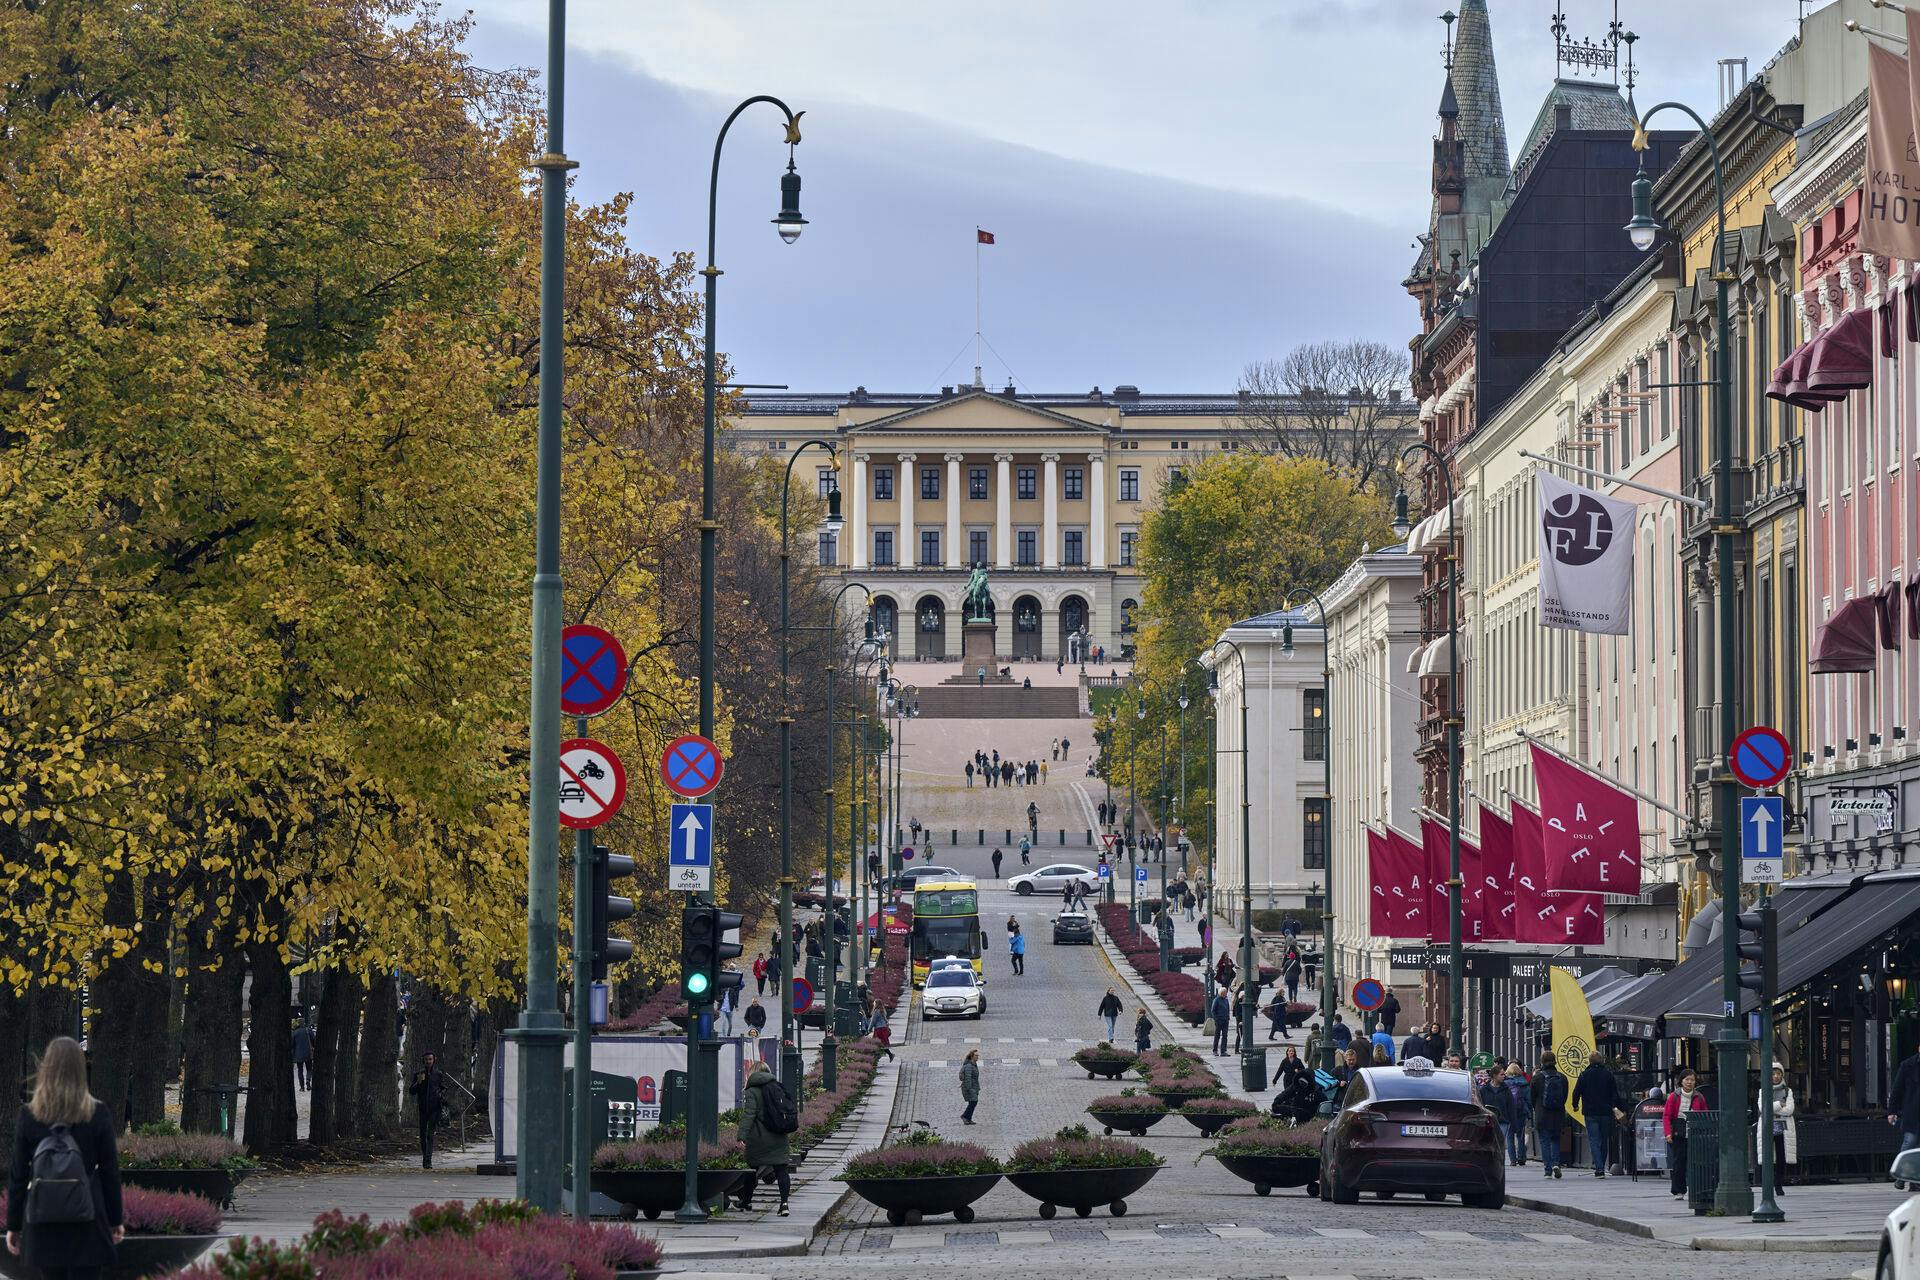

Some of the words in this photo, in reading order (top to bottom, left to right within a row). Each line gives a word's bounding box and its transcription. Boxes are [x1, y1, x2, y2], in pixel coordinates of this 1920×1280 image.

[1872, 170, 1909, 190] KARL
[1830, 799, 1884, 809] Victoria
[1100, 867, 1107, 876] P
[1138, 870, 1145, 879] P
[1392, 954, 1421, 964] PALEET
[1512, 965, 1535, 977] PALEET
